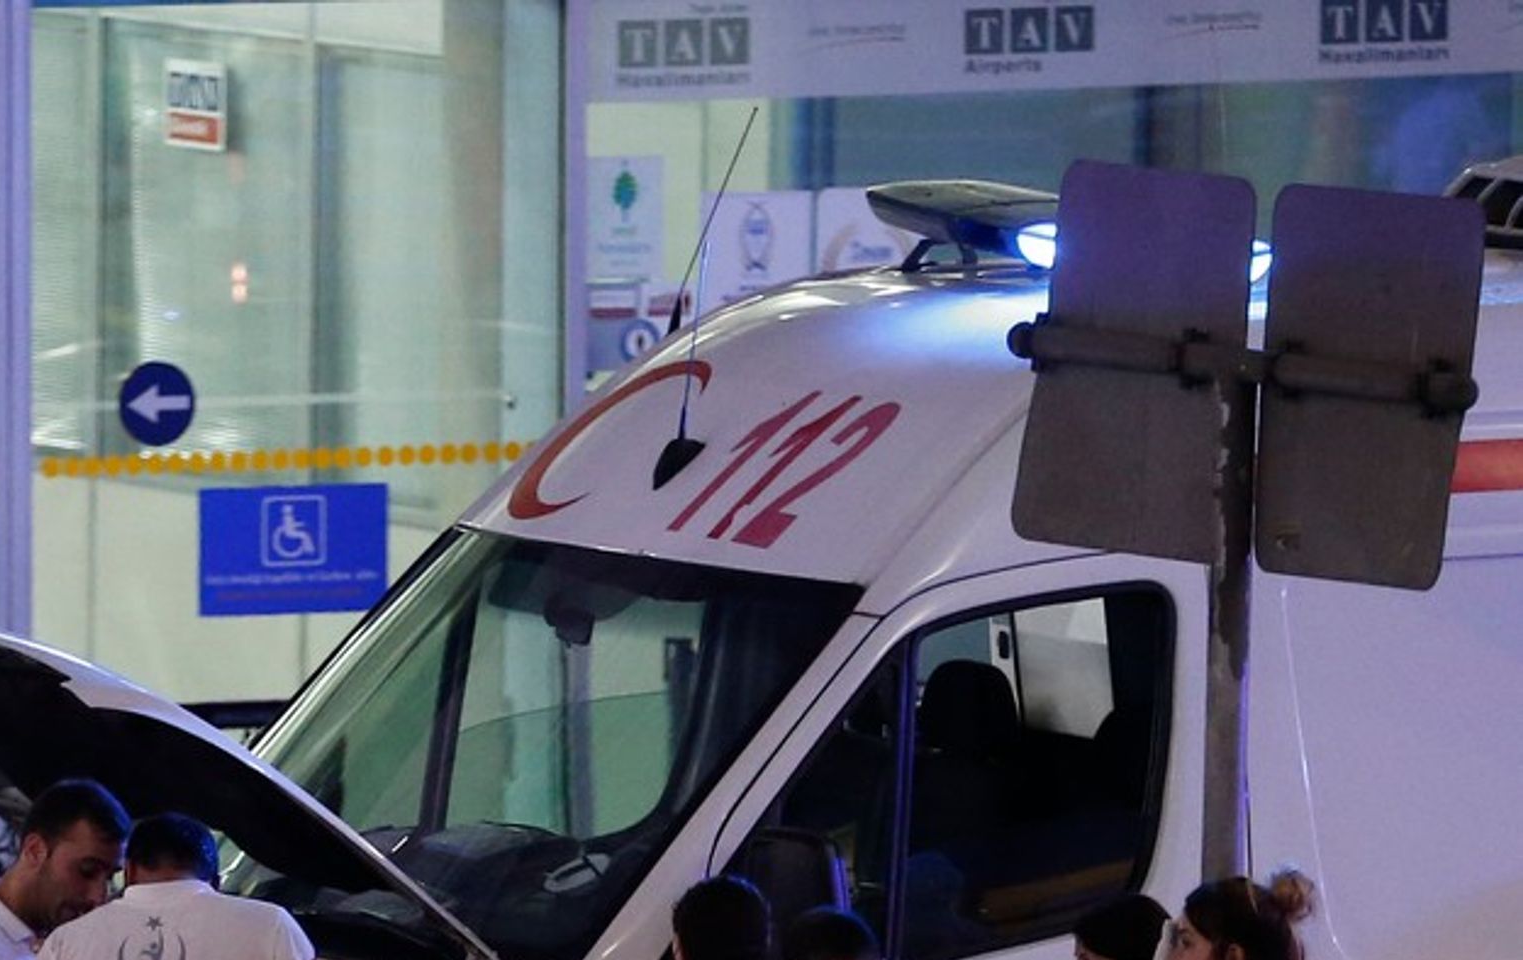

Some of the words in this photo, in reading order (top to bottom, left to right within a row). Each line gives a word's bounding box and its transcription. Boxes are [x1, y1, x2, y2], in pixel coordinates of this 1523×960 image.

[620, 21, 747, 65] TAV
[966, 9, 1092, 51] TAV
[1322, 2, 1446, 41] TAV
[667, 390, 901, 548] 112
